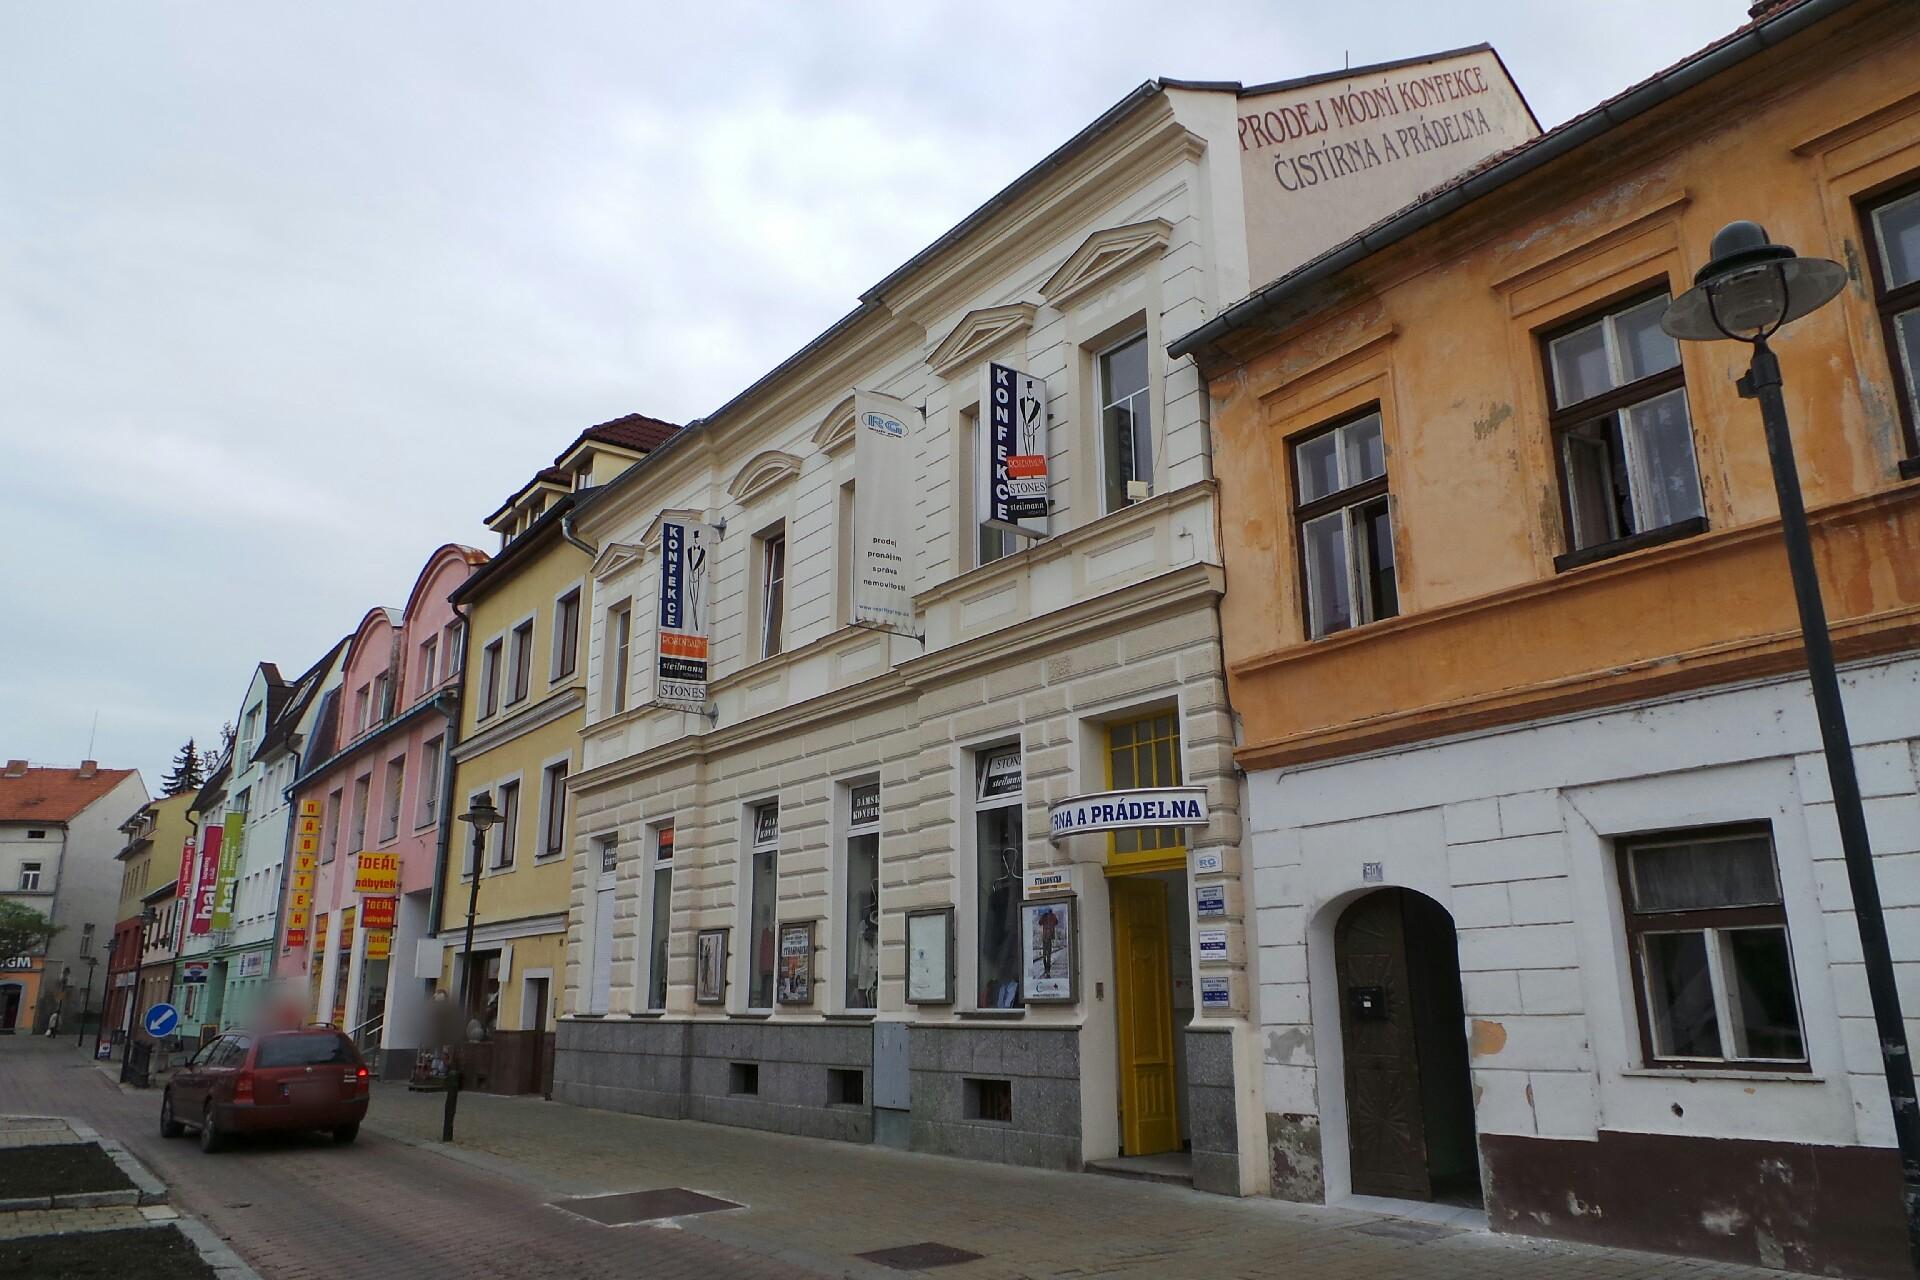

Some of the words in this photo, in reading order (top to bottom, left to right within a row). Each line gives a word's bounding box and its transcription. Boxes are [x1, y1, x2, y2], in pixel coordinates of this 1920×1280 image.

[1238, 99, 1329, 151] PRODEJ
[1330, 78, 1400, 128] MÓDNÍ
[1397, 66, 1489, 113] KONFEKCE
[1274, 139, 1382, 192] ČISTÍRNA
[1382, 132, 1400, 162] A
[1399, 107, 1491, 159] PRÁDELNA
[996, 367, 1009, 521] KONFEKCE
[1009, 481, 1046, 495] STONES
[1010, 501, 1045, 512] steilmann
[872, 537, 897, 548] prodej
[667, 526, 679, 627] KONFEKCE
[872, 566, 898, 576] správa
[662, 662, 704, 675] steilmann
[661, 684, 705, 699] STONES
[1076, 807, 1087, 825] A
[1091, 797, 1202, 823] PRÁDELNA
[355, 879, 397, 891] nábytek
